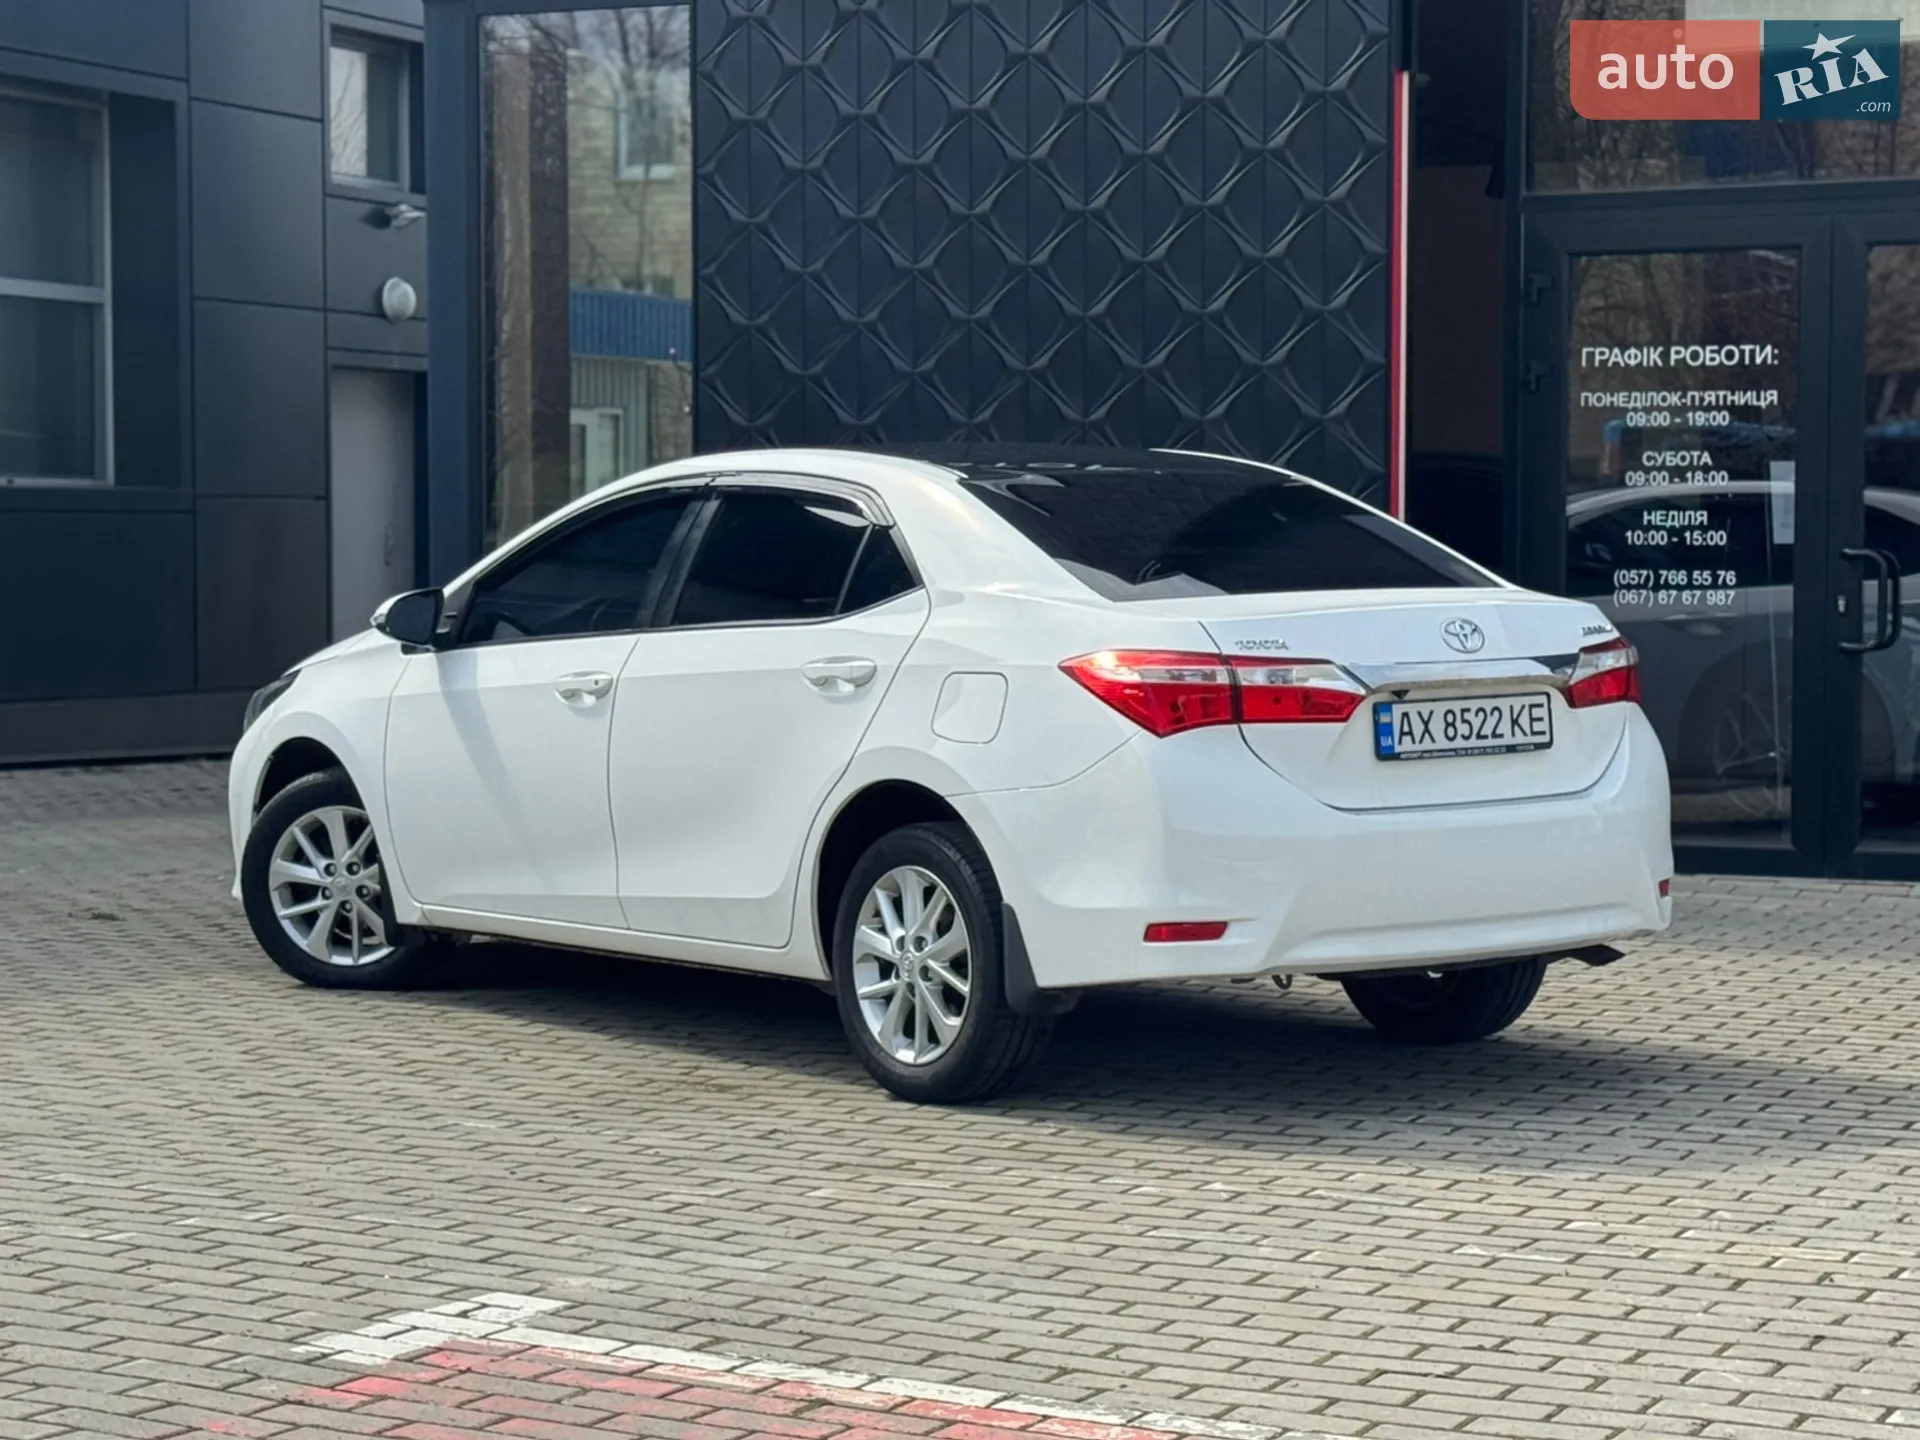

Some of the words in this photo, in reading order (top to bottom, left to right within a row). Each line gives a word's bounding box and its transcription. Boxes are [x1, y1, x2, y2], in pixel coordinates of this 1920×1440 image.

[1581, 346, 1663, 368] ГРАФІК
[1670, 345, 1779, 367] РОБОТИ:
[1580, 390, 1778, 409] ПОНЕДІЛОК-П'ЯТНИЦЯ
[1626, 412, 1670, 427] 09:00
[1687, 411, 1730, 426] 19:00
[1642, 451, 1712, 467] СУБОТА
[1625, 471, 1669, 486] 09:00
[1685, 471, 1729, 486] 18:00
[1643, 511, 1708, 528] НЕДІЛЯ
[1625, 531, 1668, 546] 10:00
[1684, 531, 1727, 546] 15:00
[1613, 570, 1654, 587] (057)
[1659, 570, 1688, 585] 766
[1692, 570, 1712, 585] 55
[1716, 570, 1736, 585] 76
[1613, 590, 1654, 607] (067)
[1658, 590, 1678, 605] 67
[1682, 590, 1701, 605] 67
[1706, 590, 1736, 605] 987
[1398, 710, 1437, 746] AX
[1443, 706, 1504, 742] 8522
[1509, 703, 1547, 738] KE
[1380, 736, 1393, 747] UA
